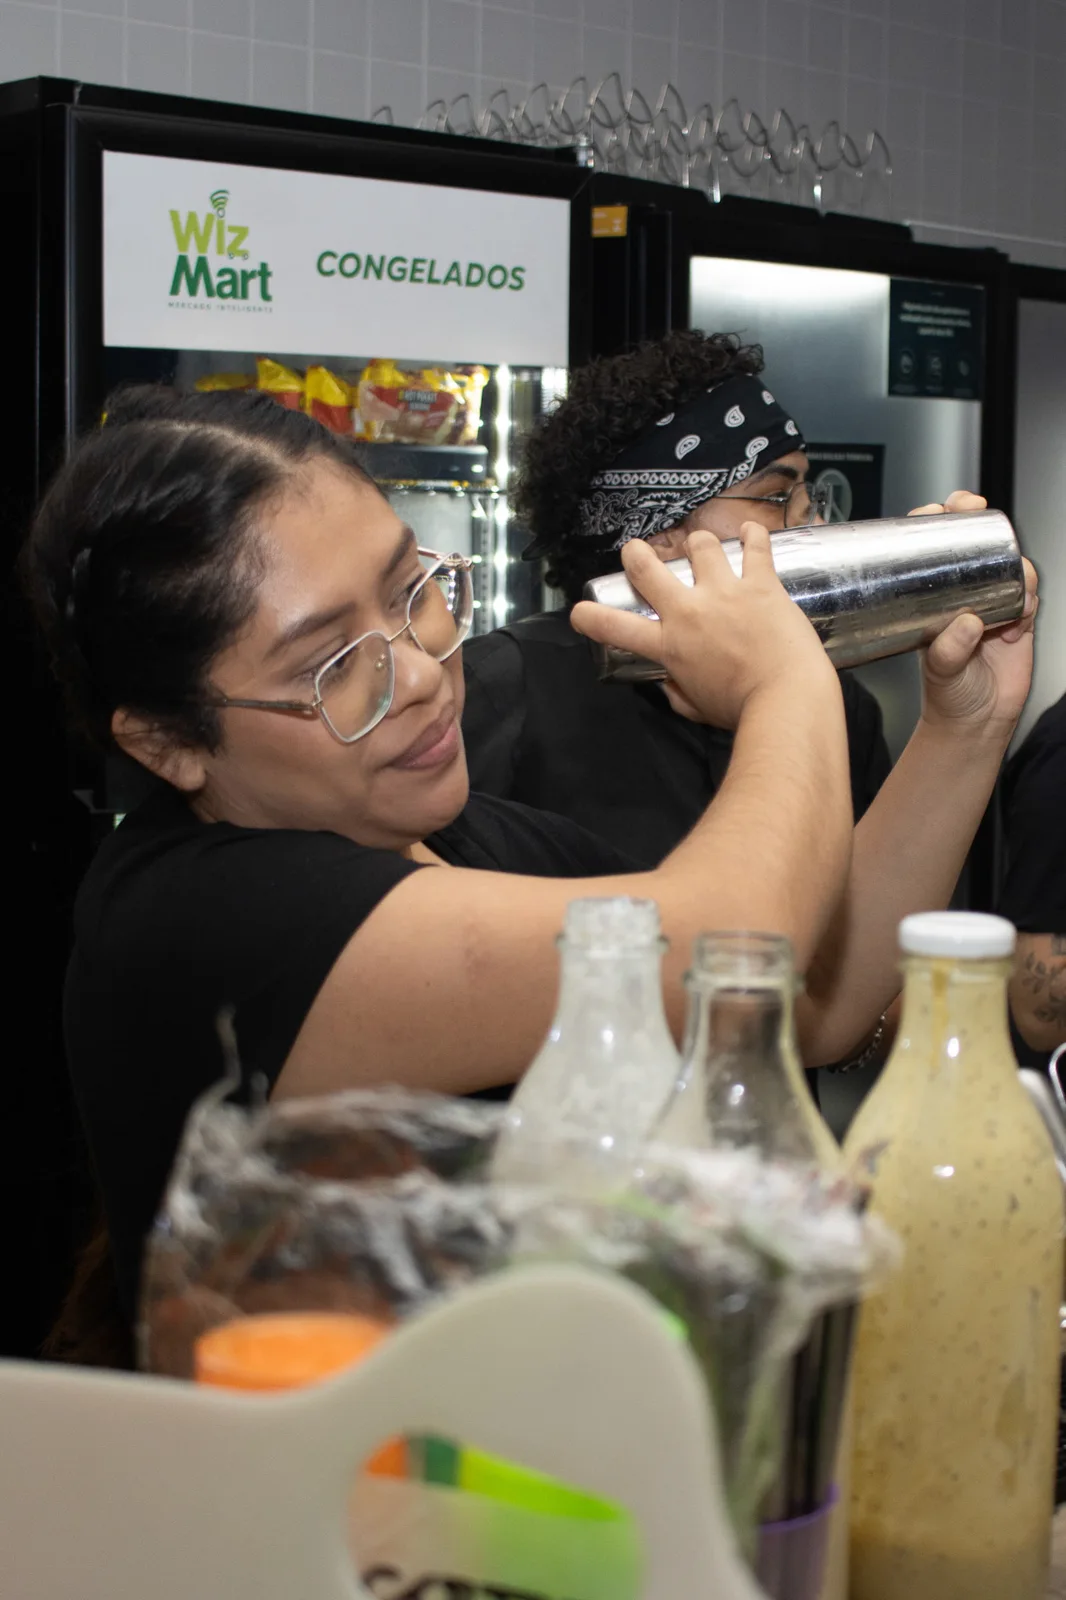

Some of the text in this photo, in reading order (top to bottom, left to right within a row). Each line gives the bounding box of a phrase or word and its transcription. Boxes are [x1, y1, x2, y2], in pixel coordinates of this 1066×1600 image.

[169, 208, 249, 258] Wiz
[169, 254, 272, 301] Mart
[316, 250, 526, 291] CONGELADOS
